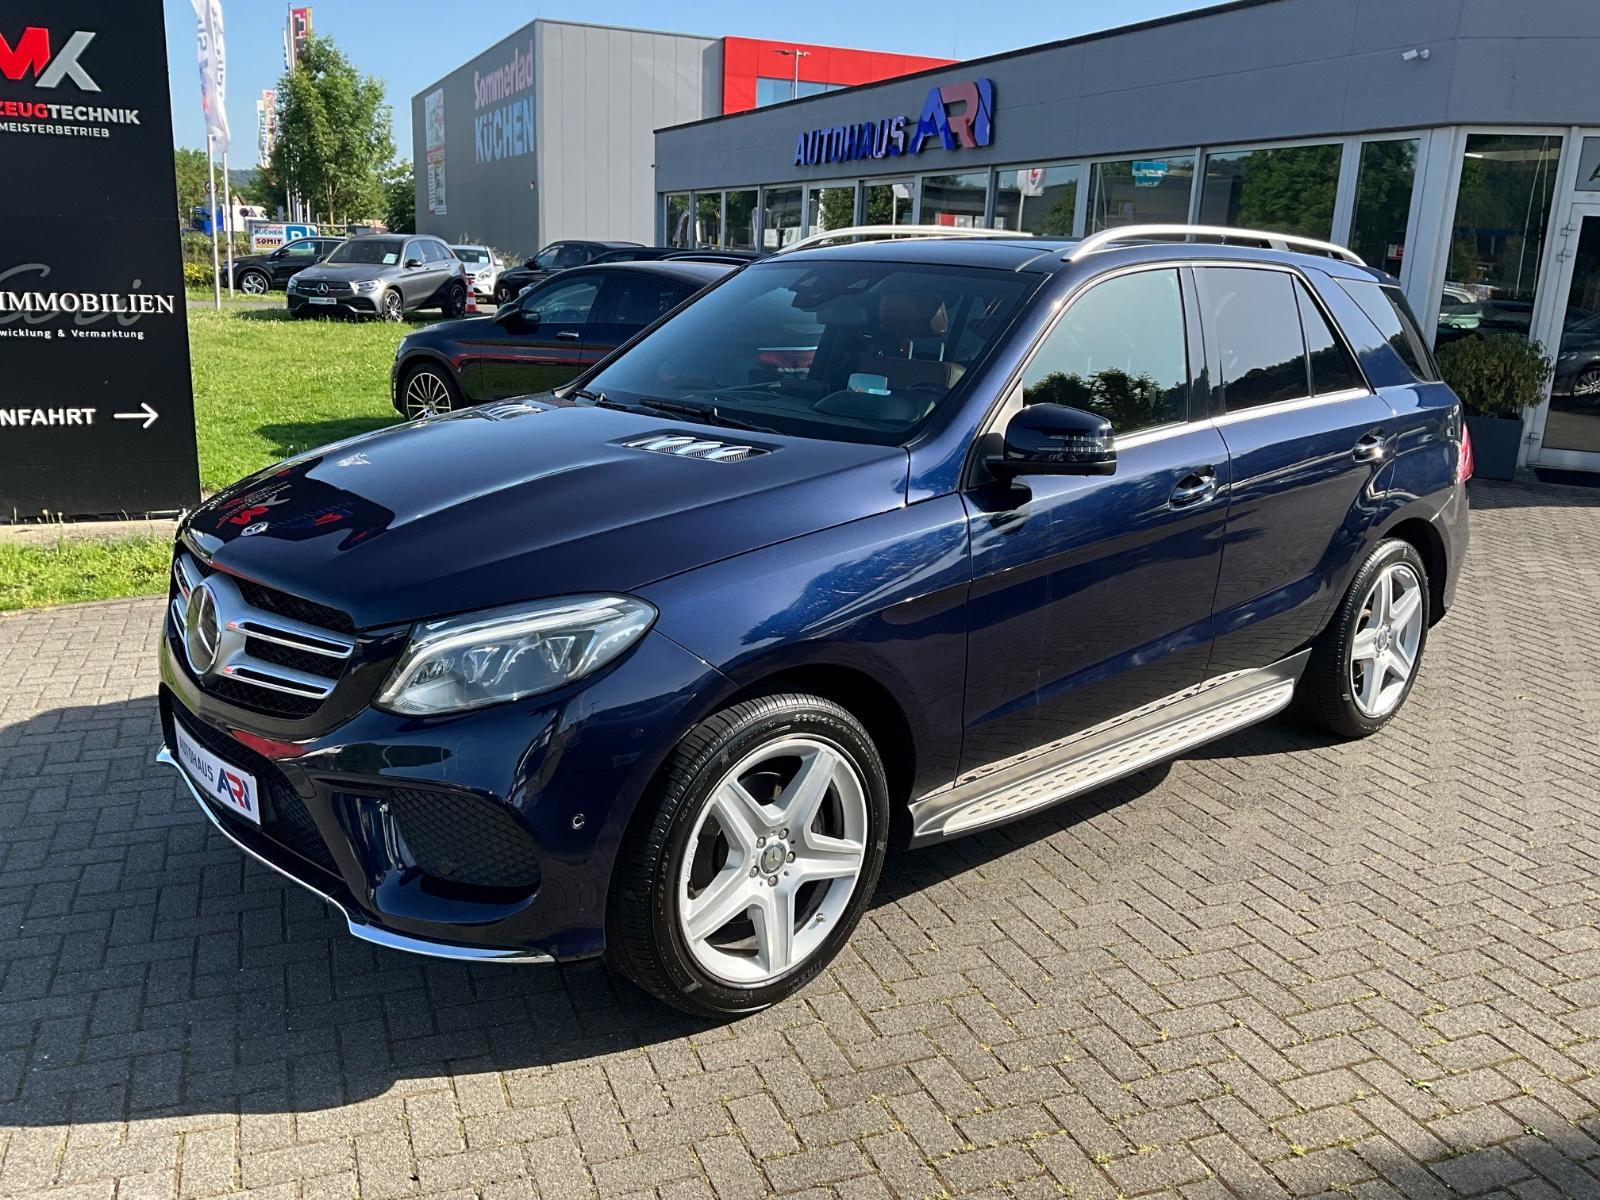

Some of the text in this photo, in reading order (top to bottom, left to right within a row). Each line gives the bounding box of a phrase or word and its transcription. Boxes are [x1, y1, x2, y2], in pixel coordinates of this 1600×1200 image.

[474, 40, 534, 111] Sommerlad
[0, 122, 109, 138] MEISTERBETRIEB
[474, 96, 535, 163] KÜCHEN
[794, 78, 993, 166] AUTOHAUS ARI
[0, 291, 174, 314] IMMOBILIEN
[0, 328, 144, 340] wicklung & Vermarktung
[0, 408, 96, 426] NFAHRT
[179, 736, 252, 811] AUTOHAUS ARI
